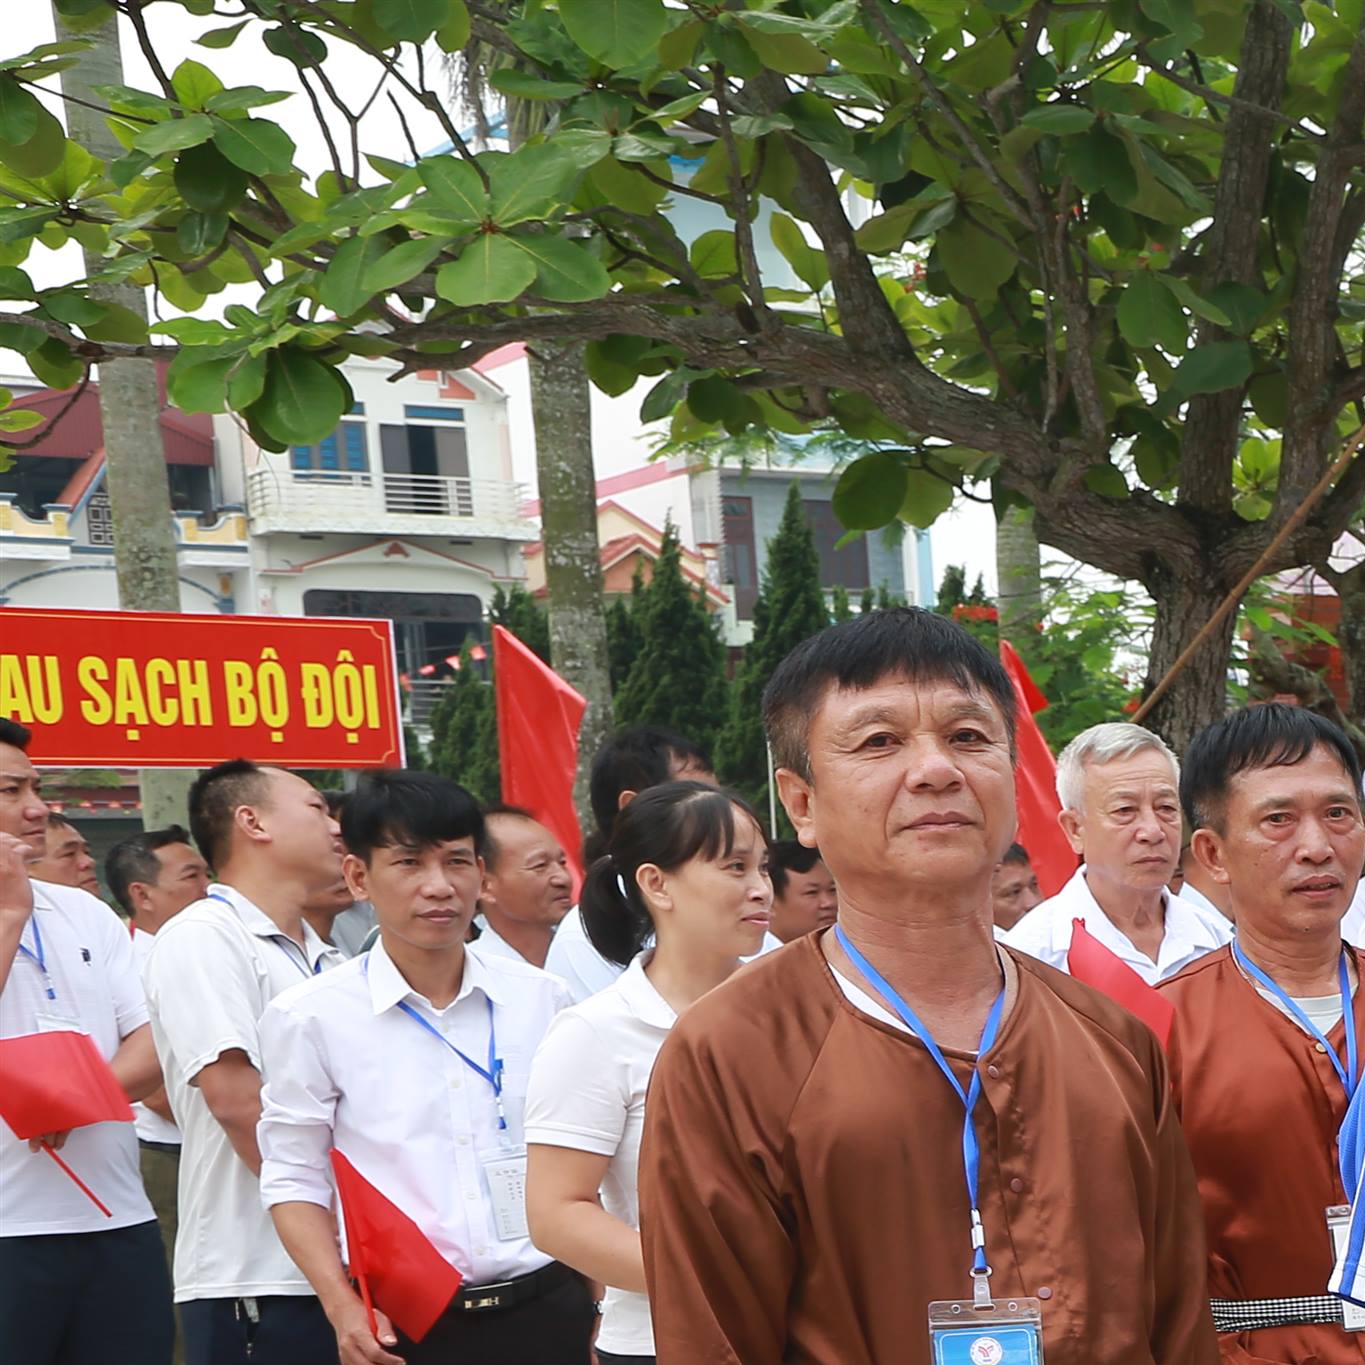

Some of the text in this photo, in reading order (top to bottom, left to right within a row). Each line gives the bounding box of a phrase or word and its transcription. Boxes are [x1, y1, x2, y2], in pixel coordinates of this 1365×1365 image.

[77, 655, 213, 741] SẠCH
[224, 647, 289, 743] BỘ
[301, 649, 380, 744] ĐỘI
